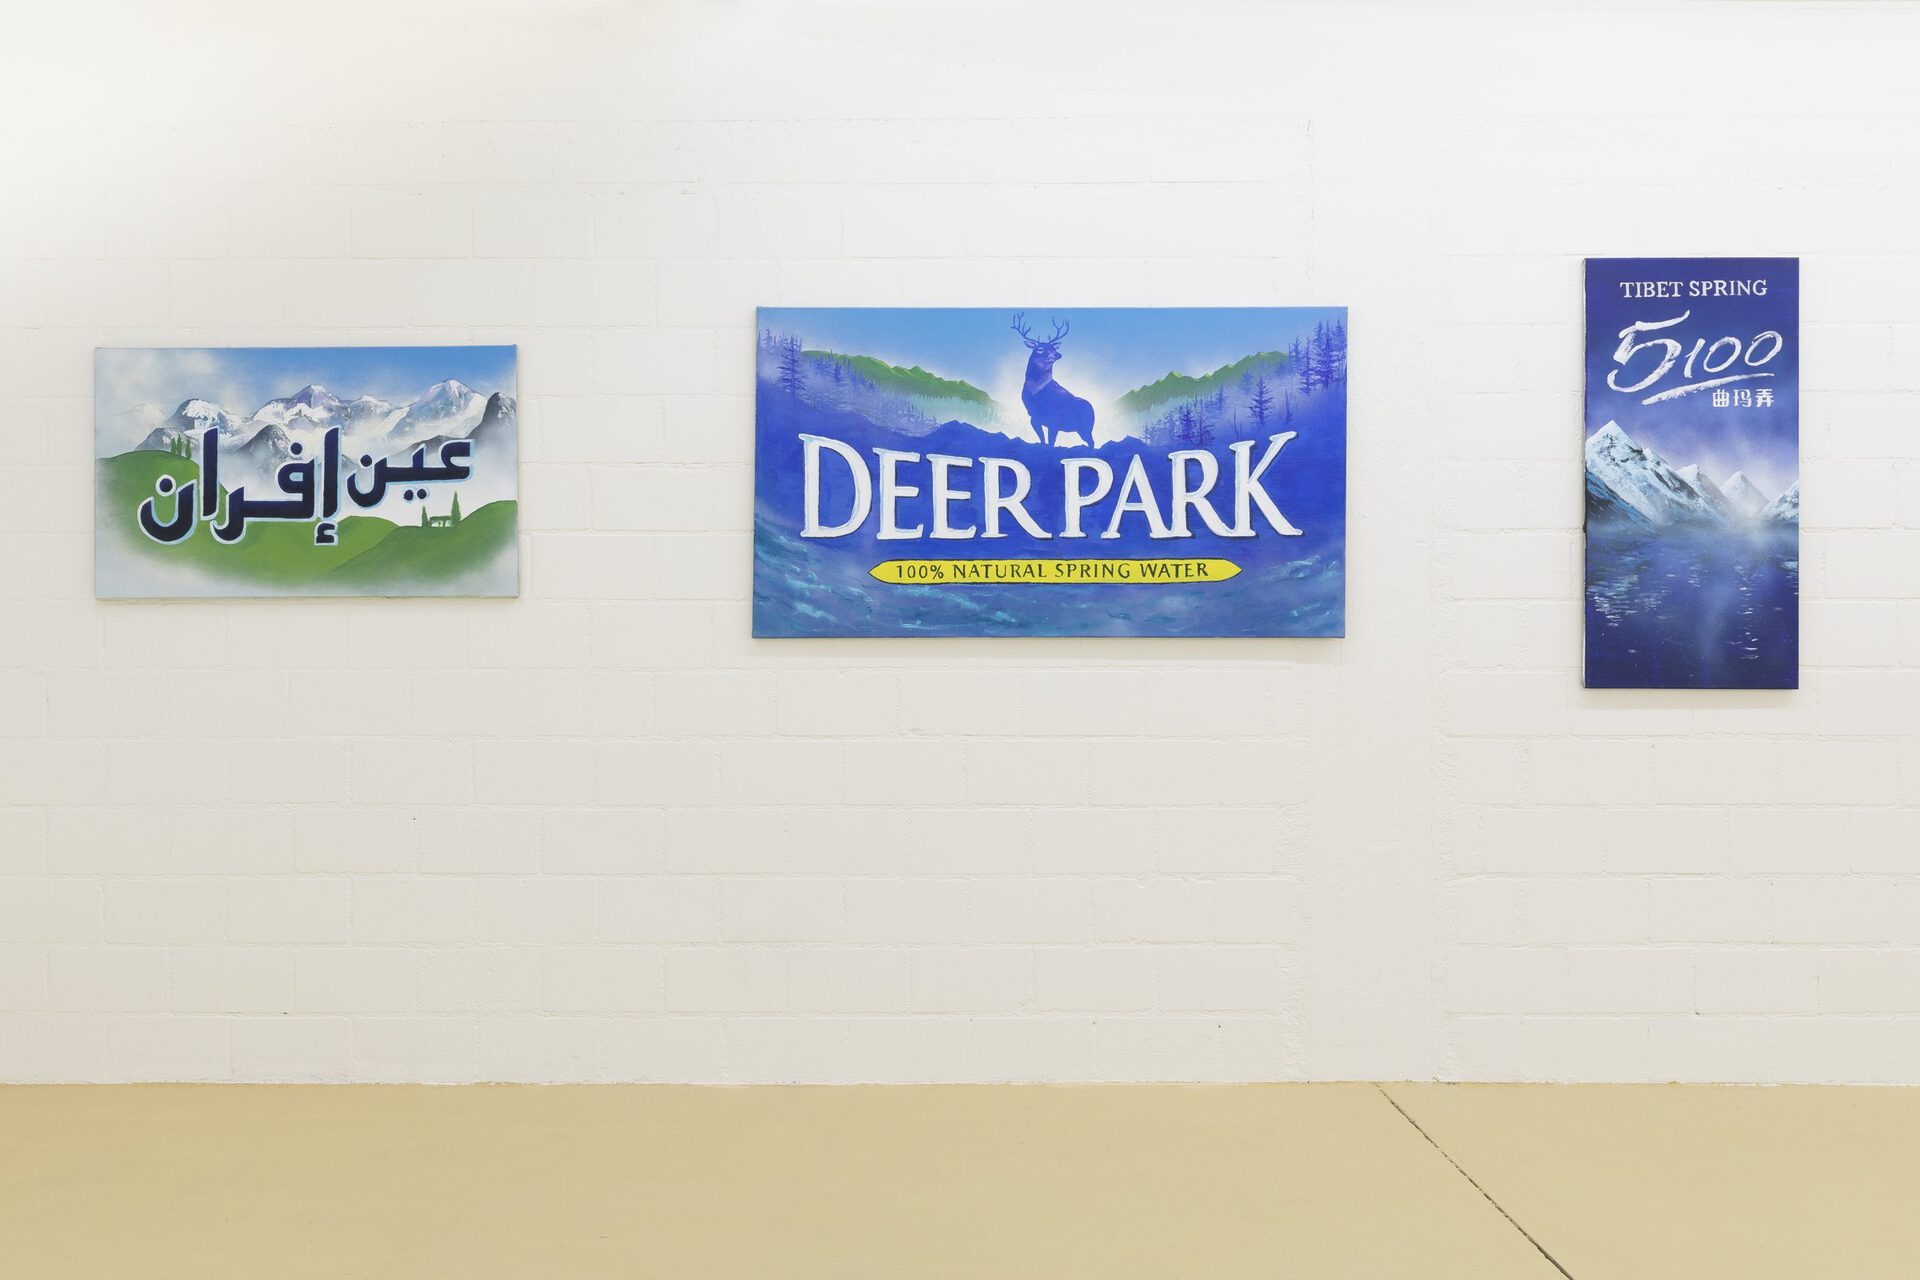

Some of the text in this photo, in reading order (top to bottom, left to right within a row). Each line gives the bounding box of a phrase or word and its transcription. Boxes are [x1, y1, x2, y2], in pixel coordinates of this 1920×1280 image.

[1619, 279, 1768, 298] TIBET SPRING
[1606, 309, 1783, 393] 5100
[1711, 388, 1775, 408] 曲玛弄
[137, 424, 475, 546] عين إفران
[798, 430, 1304, 541] DEER PARK
[895, 561, 1210, 581] 100% NATURAL SPRING WATER
